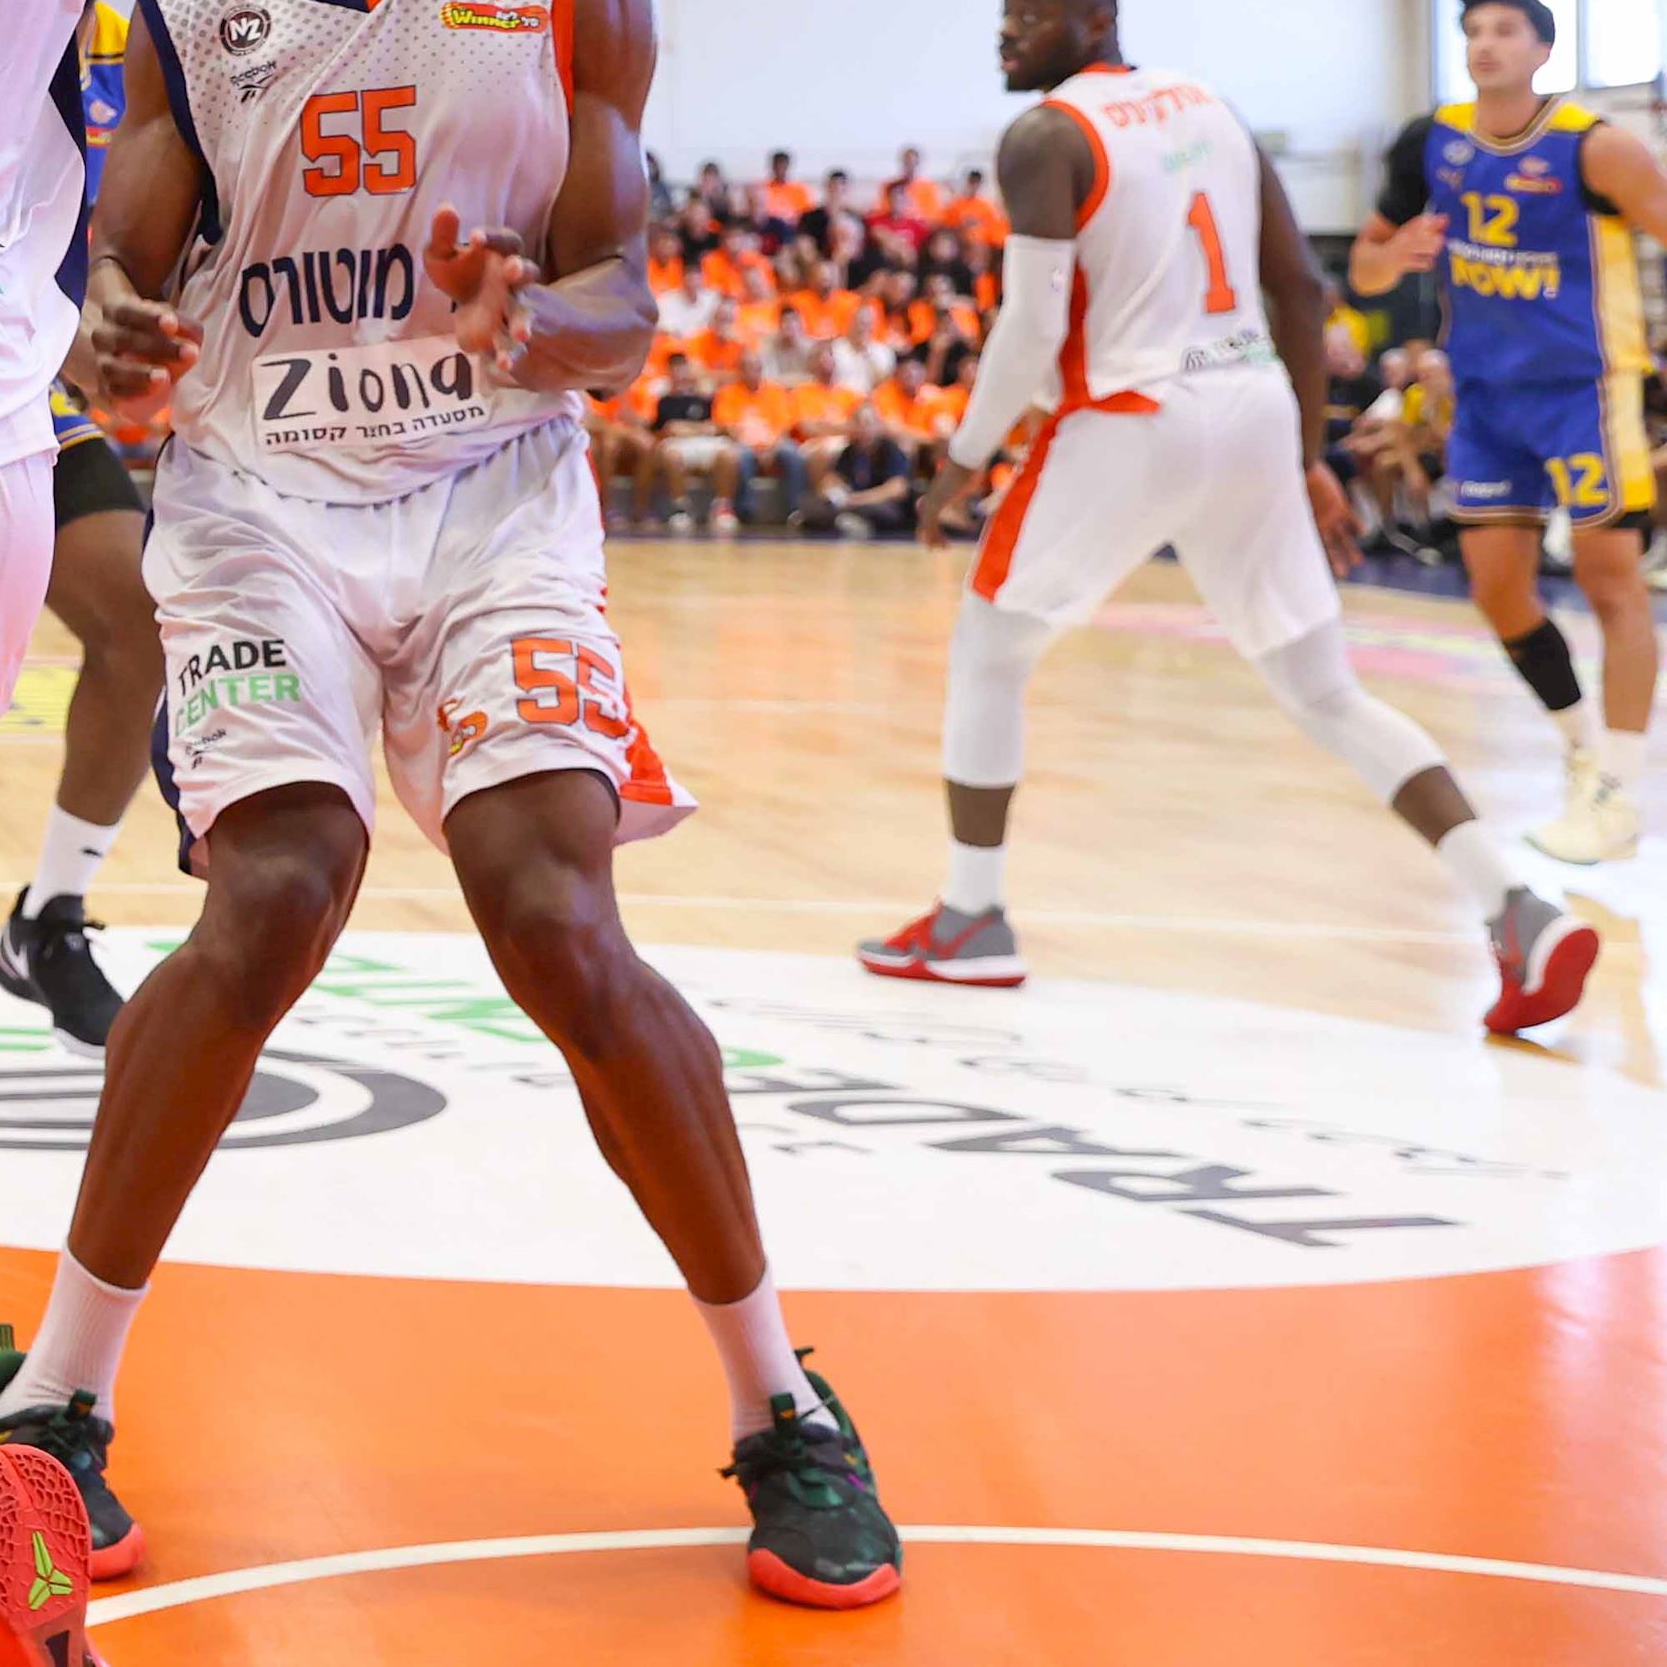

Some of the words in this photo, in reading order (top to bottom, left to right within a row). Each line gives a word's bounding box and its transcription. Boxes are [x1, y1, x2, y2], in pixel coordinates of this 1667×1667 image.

[300, 85, 417, 198] 55
[1461, 191, 1519, 247] 12
[239, 244, 415, 337] מוטורס
[260, 352, 473, 421] Ziona
[265, 426, 348, 446] קסומה
[411, 406, 485, 431] מסעדה
[1543, 452, 1612, 506] 12
[178, 638, 287, 697] TRADE
[510, 637, 630, 739] 55
[175, 673, 301, 738] CENTER
